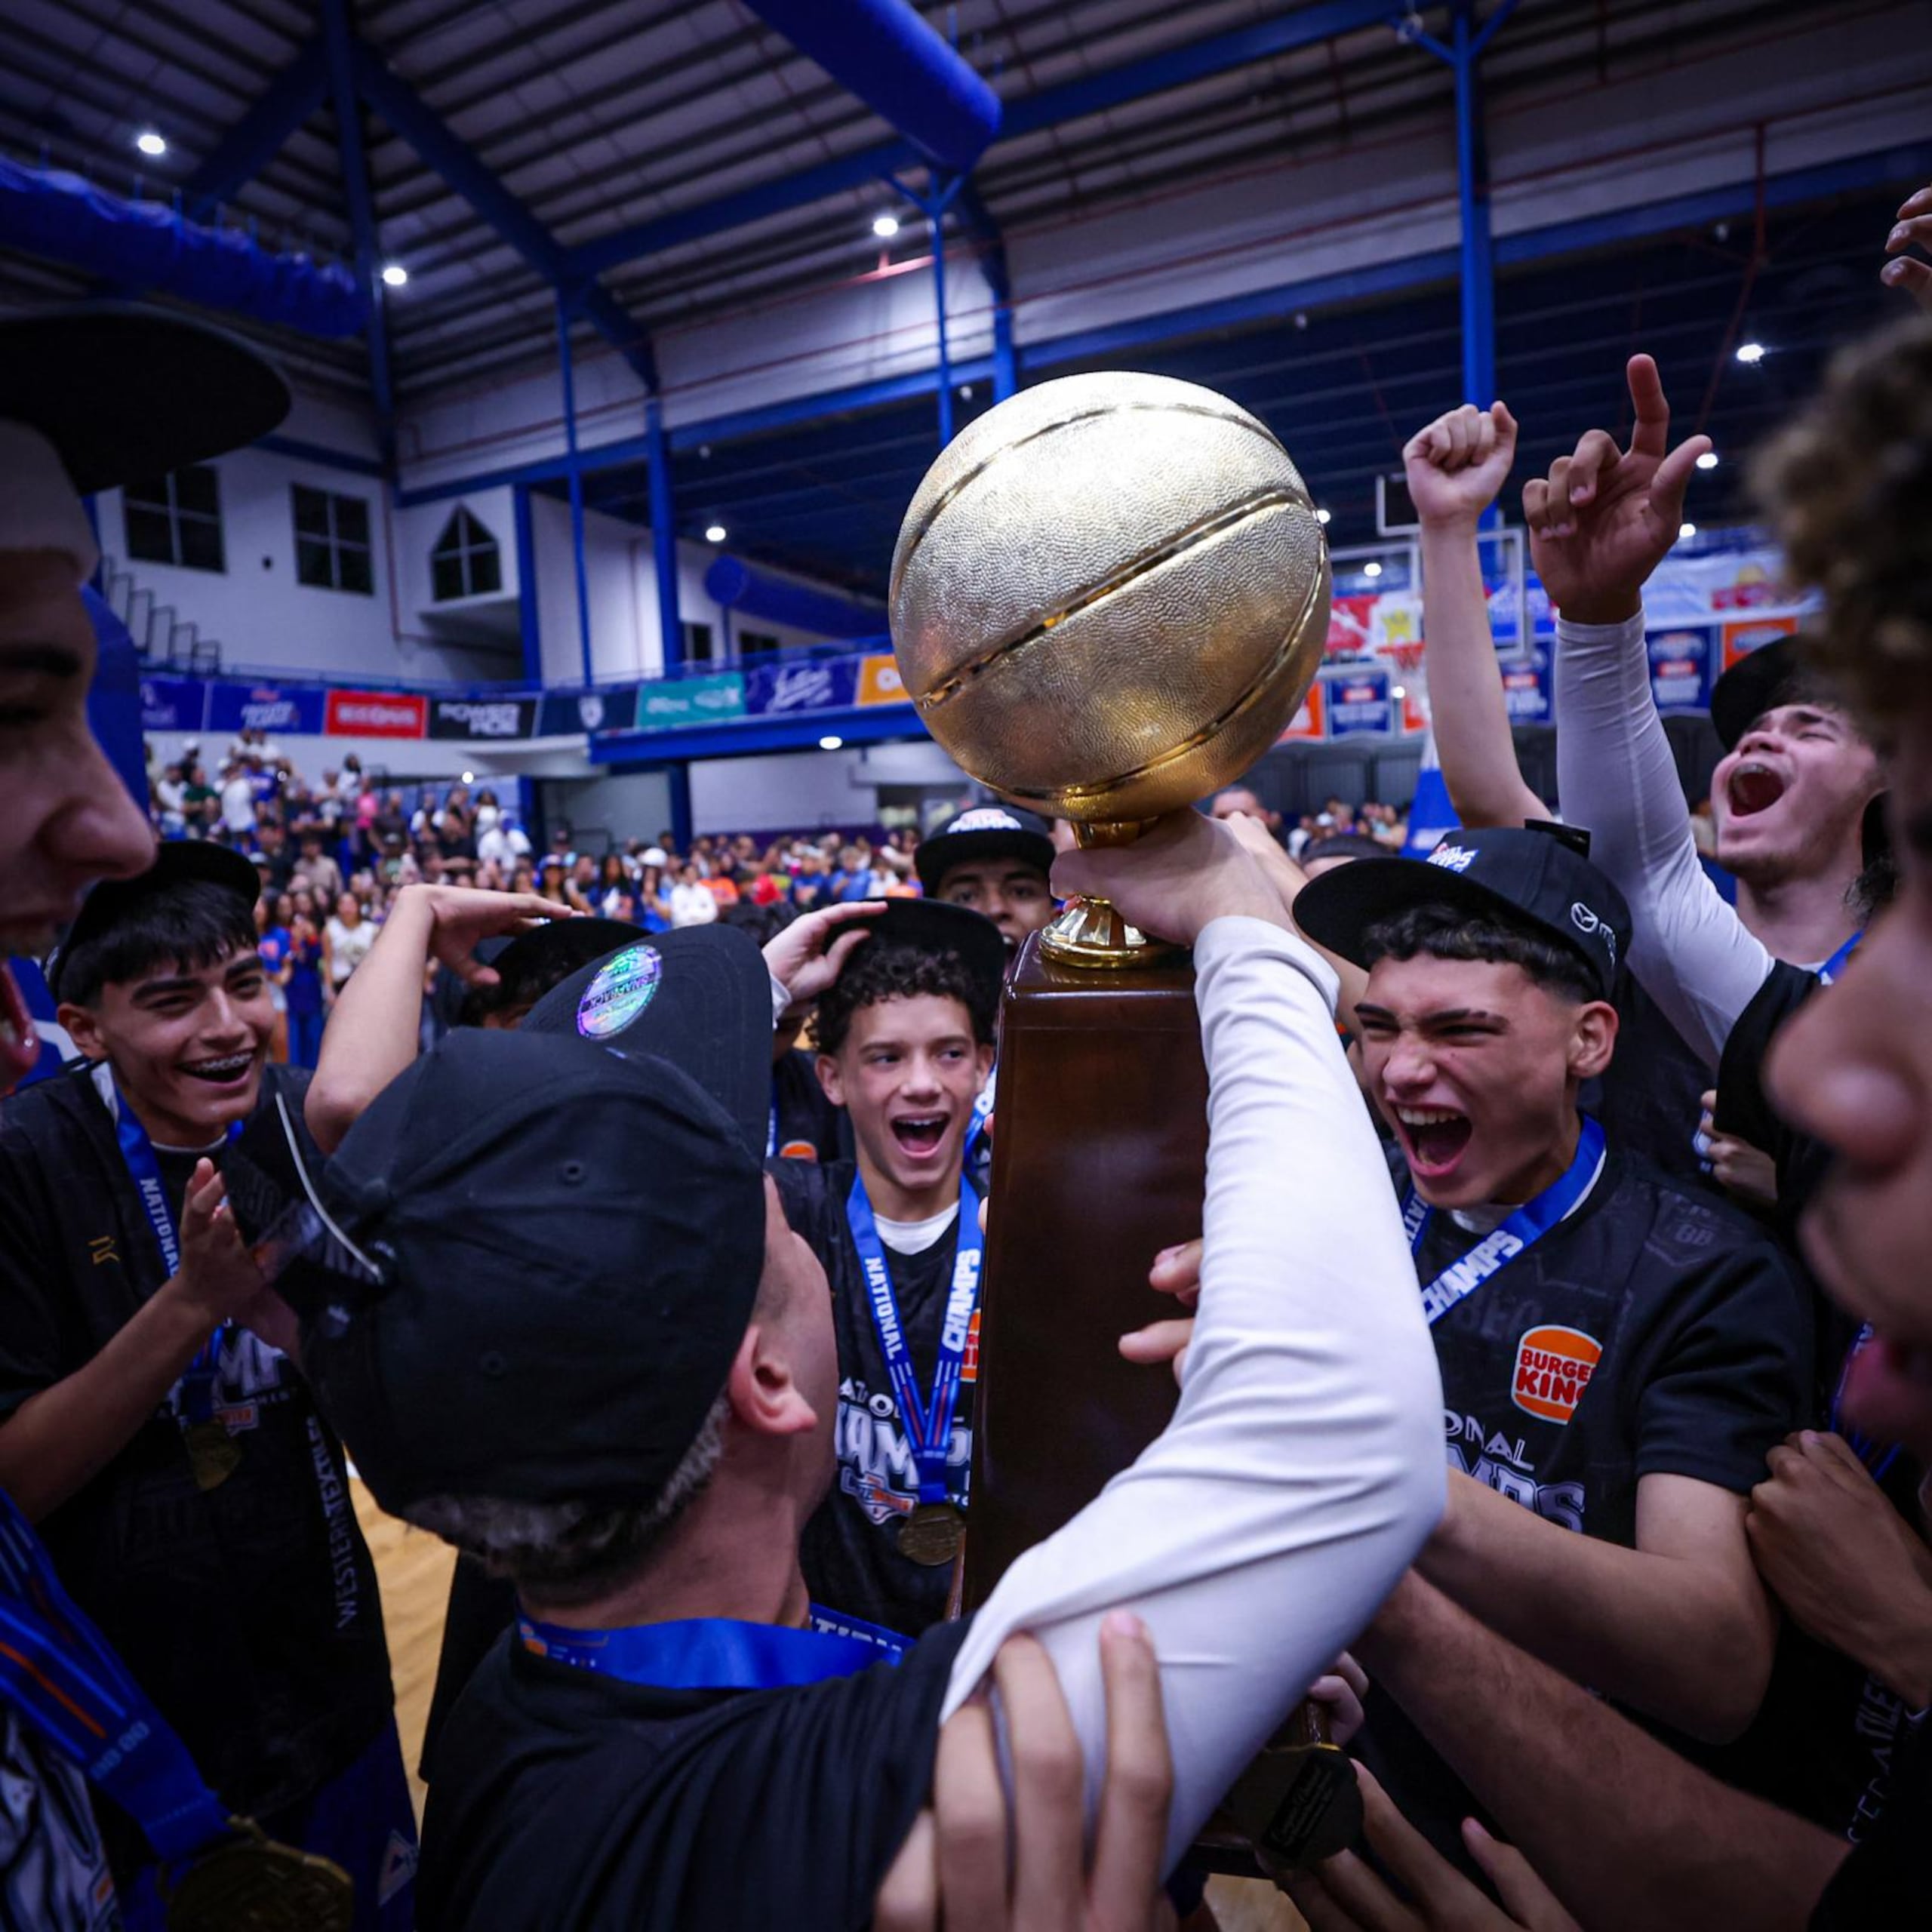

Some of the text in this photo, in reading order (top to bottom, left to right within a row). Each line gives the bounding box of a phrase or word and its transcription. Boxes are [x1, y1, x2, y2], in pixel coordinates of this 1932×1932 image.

[865, 1257, 905, 1361] NATIONAL
[942, 1248, 981, 1353] CHAMPS
[1520, 1348, 1597, 1383] BURGE
[1444, 1409, 1536, 1472] ONAL
